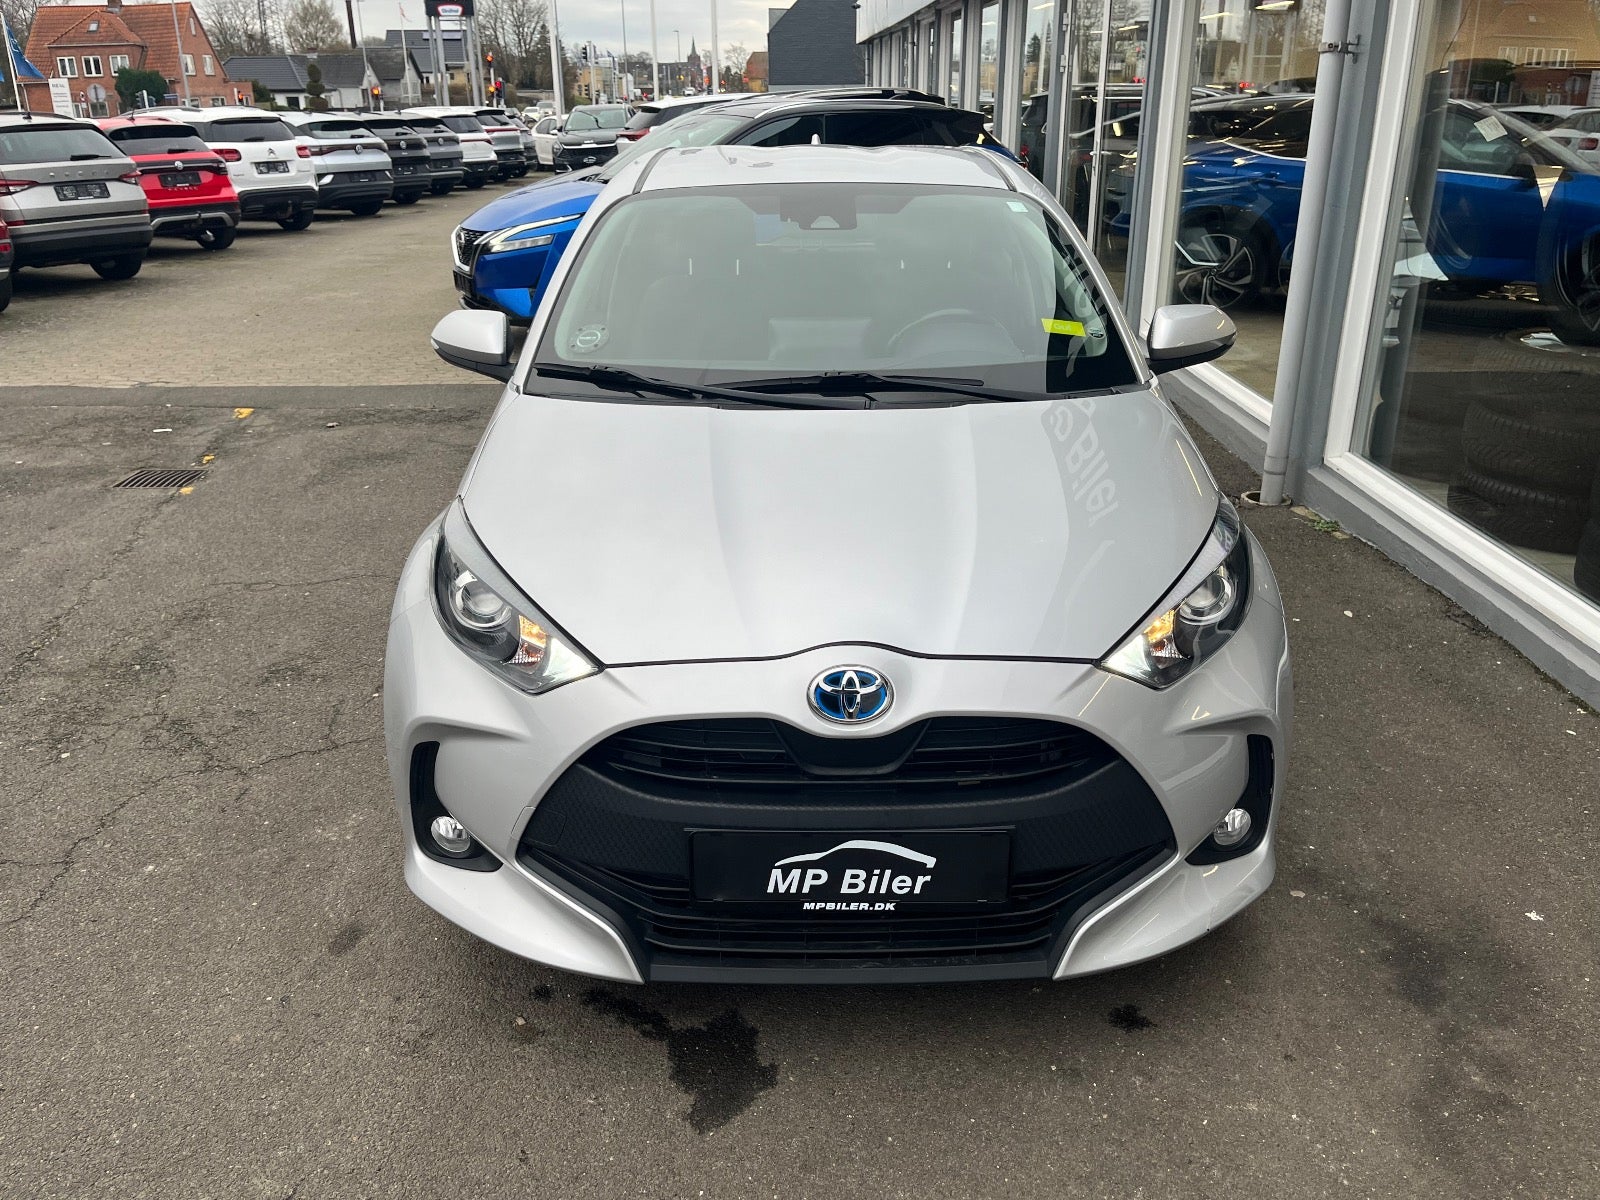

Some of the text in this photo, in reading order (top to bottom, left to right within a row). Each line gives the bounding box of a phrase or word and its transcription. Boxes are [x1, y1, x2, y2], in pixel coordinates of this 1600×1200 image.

[766, 868, 931, 894] MP Biler
[803, 902, 896, 911] MPBILER.DK
